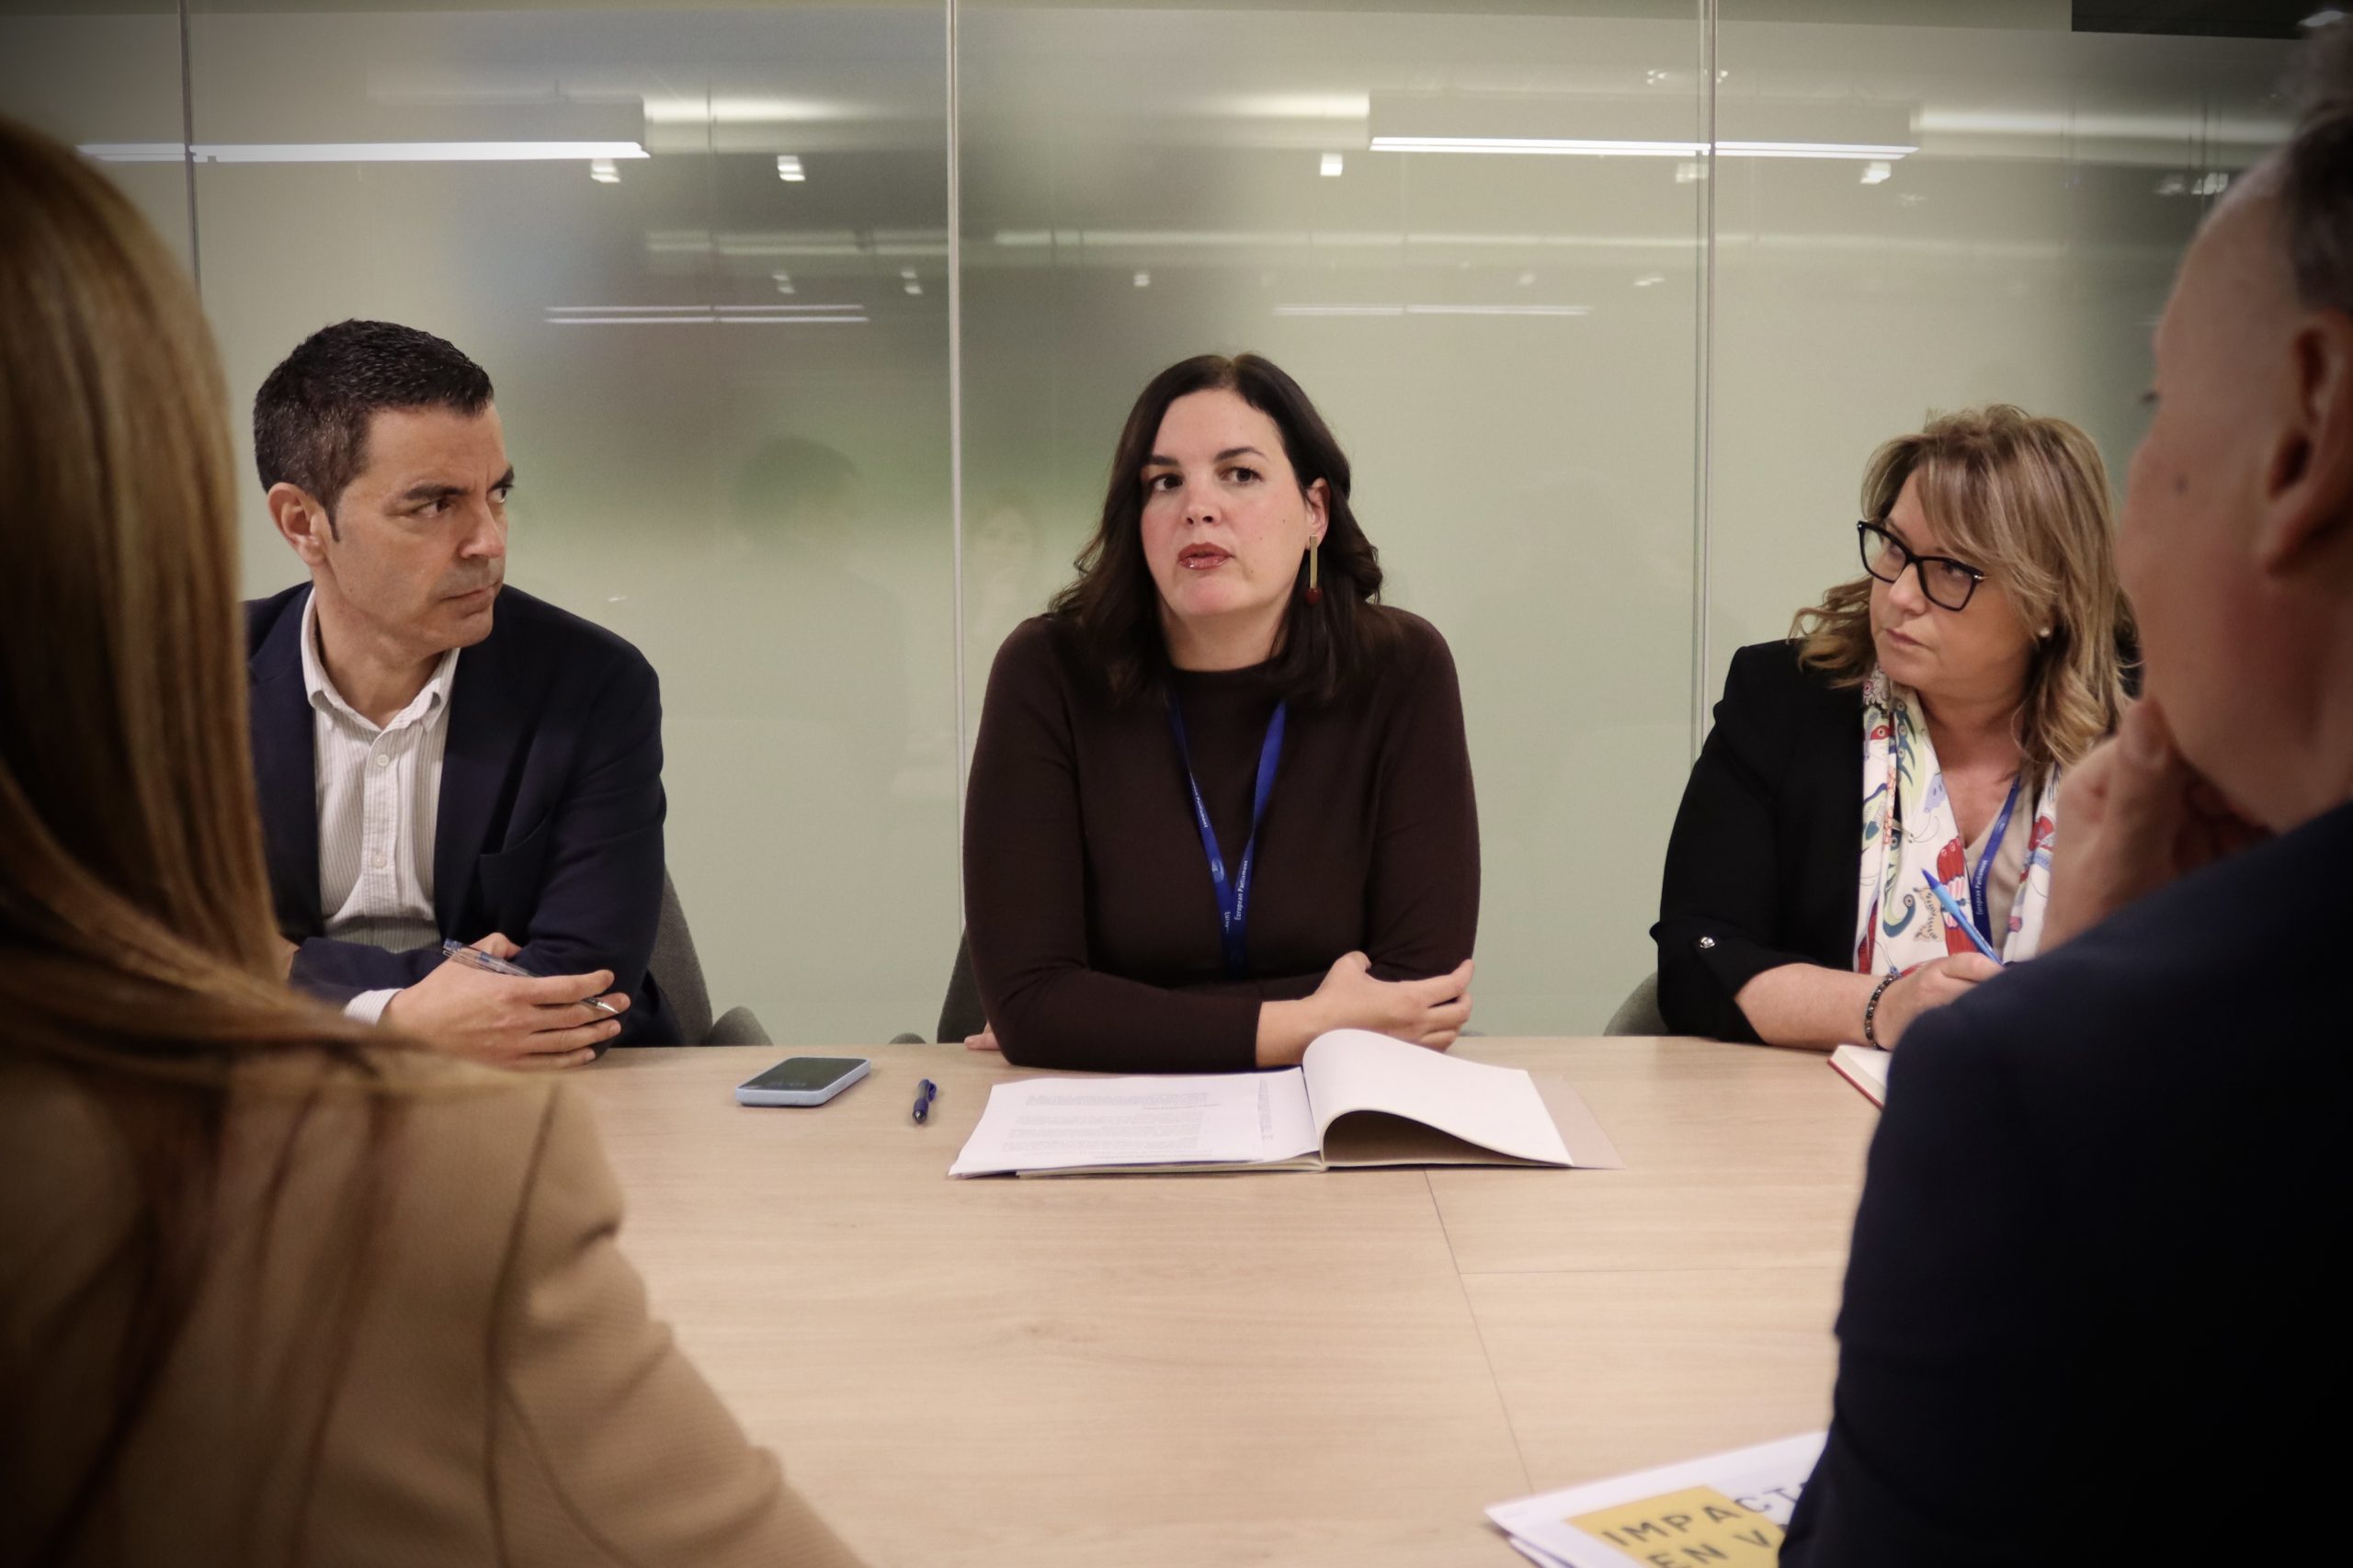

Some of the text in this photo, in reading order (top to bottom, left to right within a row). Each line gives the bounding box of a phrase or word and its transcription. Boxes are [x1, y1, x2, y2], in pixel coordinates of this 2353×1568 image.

[1234, 860, 1248, 920] European Parliament
[1975, 860, 1988, 889] Parliament
[1601, 1482, 1807, 1546] IMPACT
[1646, 1542, 1729, 1568] EN
